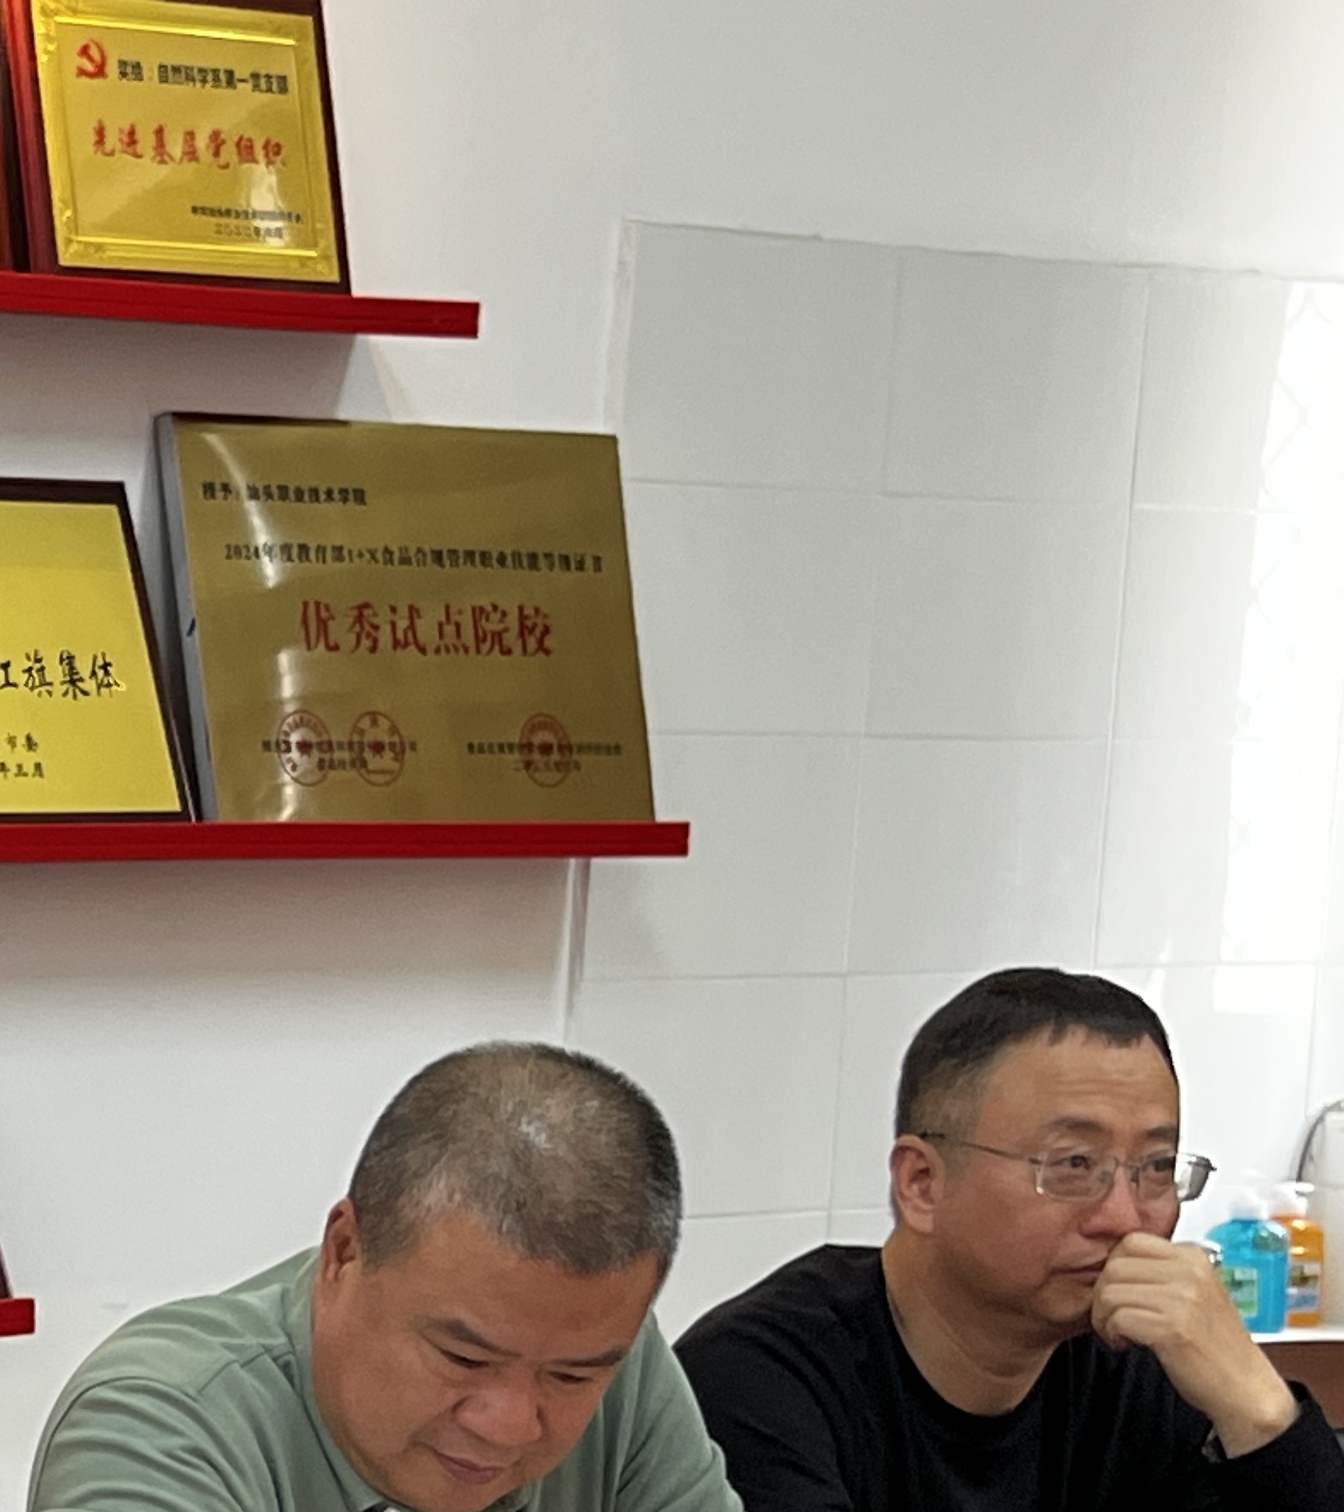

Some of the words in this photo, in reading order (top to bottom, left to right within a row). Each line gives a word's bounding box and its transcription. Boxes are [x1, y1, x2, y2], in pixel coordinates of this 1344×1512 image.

[92, 119, 287, 171] 先进基层党组织
[299, 600, 555, 657] 优秀试点院校
